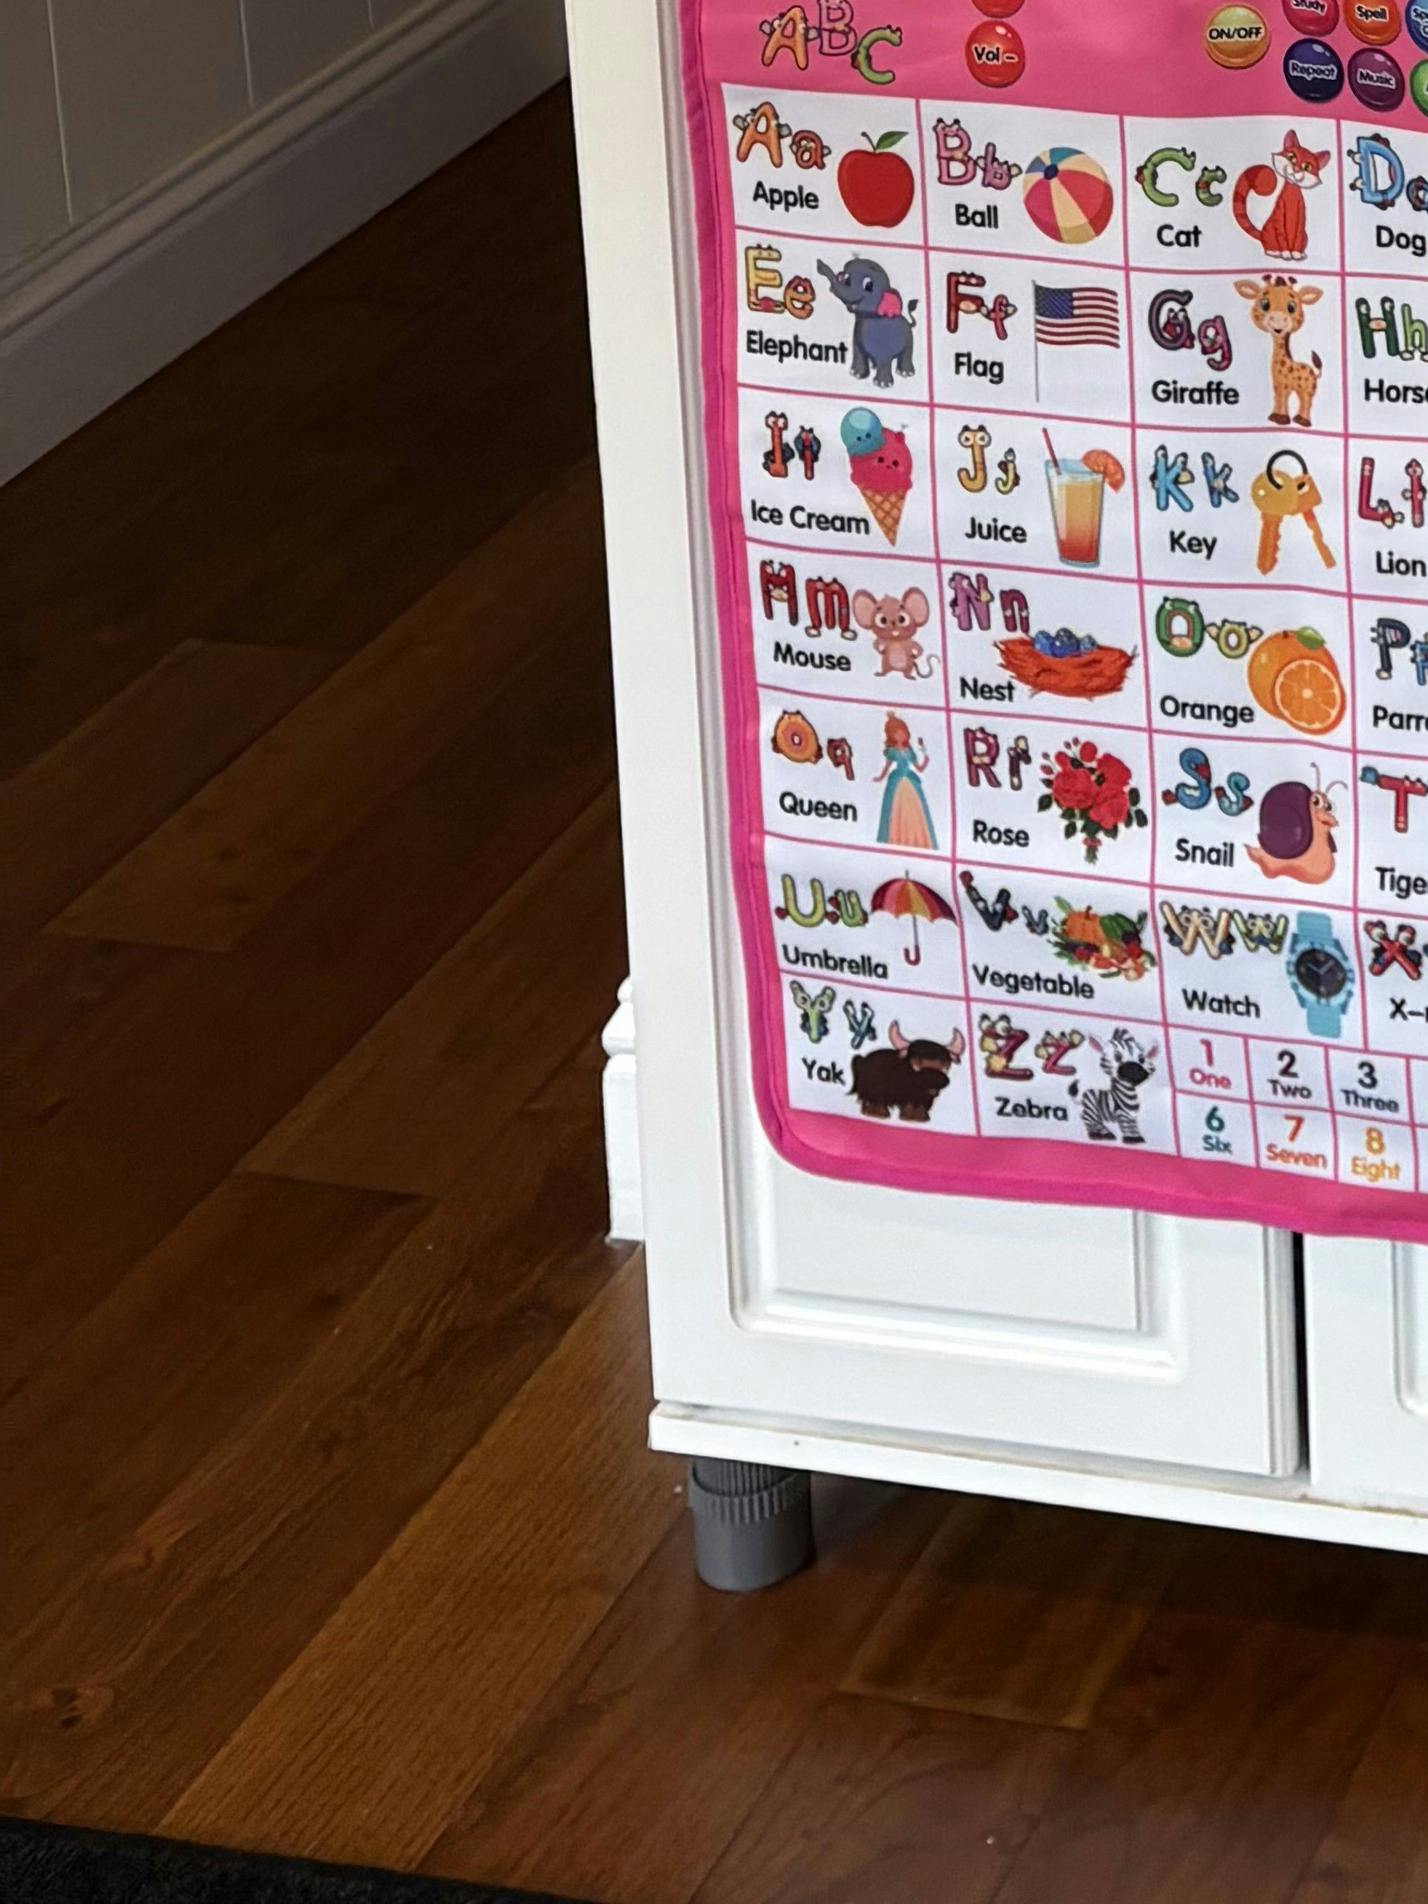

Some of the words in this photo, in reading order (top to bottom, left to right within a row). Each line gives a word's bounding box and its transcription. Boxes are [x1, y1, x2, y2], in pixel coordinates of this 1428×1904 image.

[1356, 4, 1388, 22] Spell
[1207, 24, 1264, 42] ON/OFF
[974, 46, 1000, 63] Vol
[1290, 60, 1336, 82] Repeat
[1357, 69, 1396, 88] Music
[752, 181, 820, 211] Apple
[954, 203, 1000, 230] Ball
[1155, 223, 1203, 249] Cat
[1374, 223, 1428, 257] Dog
[745, 328, 849, 365] Elephant
[953, 352, 1005, 384] Flag
[1151, 379, 1241, 409] Giraffe
[751, 499, 784, 527] Ice
[789, 504, 871, 537] Cream
[964, 517, 1028, 544] Juice
[1169, 530, 1217, 560] Key
[1375, 550, 1428, 578] Lion
[772, 640, 853, 674] Mouse
[959, 676, 1017, 703] Nest
[1159, 695, 1256, 729] Orange
[778, 790, 858, 823] Queen
[971, 819, 1031, 849] Rose
[1174, 837, 1235, 868] Snail
[780, 943, 889, 980] Umbrella
[972, 964, 1096, 1000] Vegetable
[1181, 987, 1261, 1019] Watch
[1199, 1038, 1215, 1066] 1
[1276, 1049, 1298, 1079] 2
[801, 1057, 848, 1087] Yak
[1188, 1068, 1232, 1090] One
[1356, 1061, 1379, 1089] 3
[1267, 1078, 1313, 1100] Two
[1340, 1089, 1400, 1114] Three
[994, 1095, 1070, 1122] Zebra
[1205, 1105, 1225, 1132] 6
[1283, 1114, 1305, 1143] 7
[1364, 1126, 1387, 1155] 8
[1202, 1133, 1233, 1155] Six
[1265, 1143, 1328, 1170] Seven
[1350, 1156, 1401, 1183] Eight
